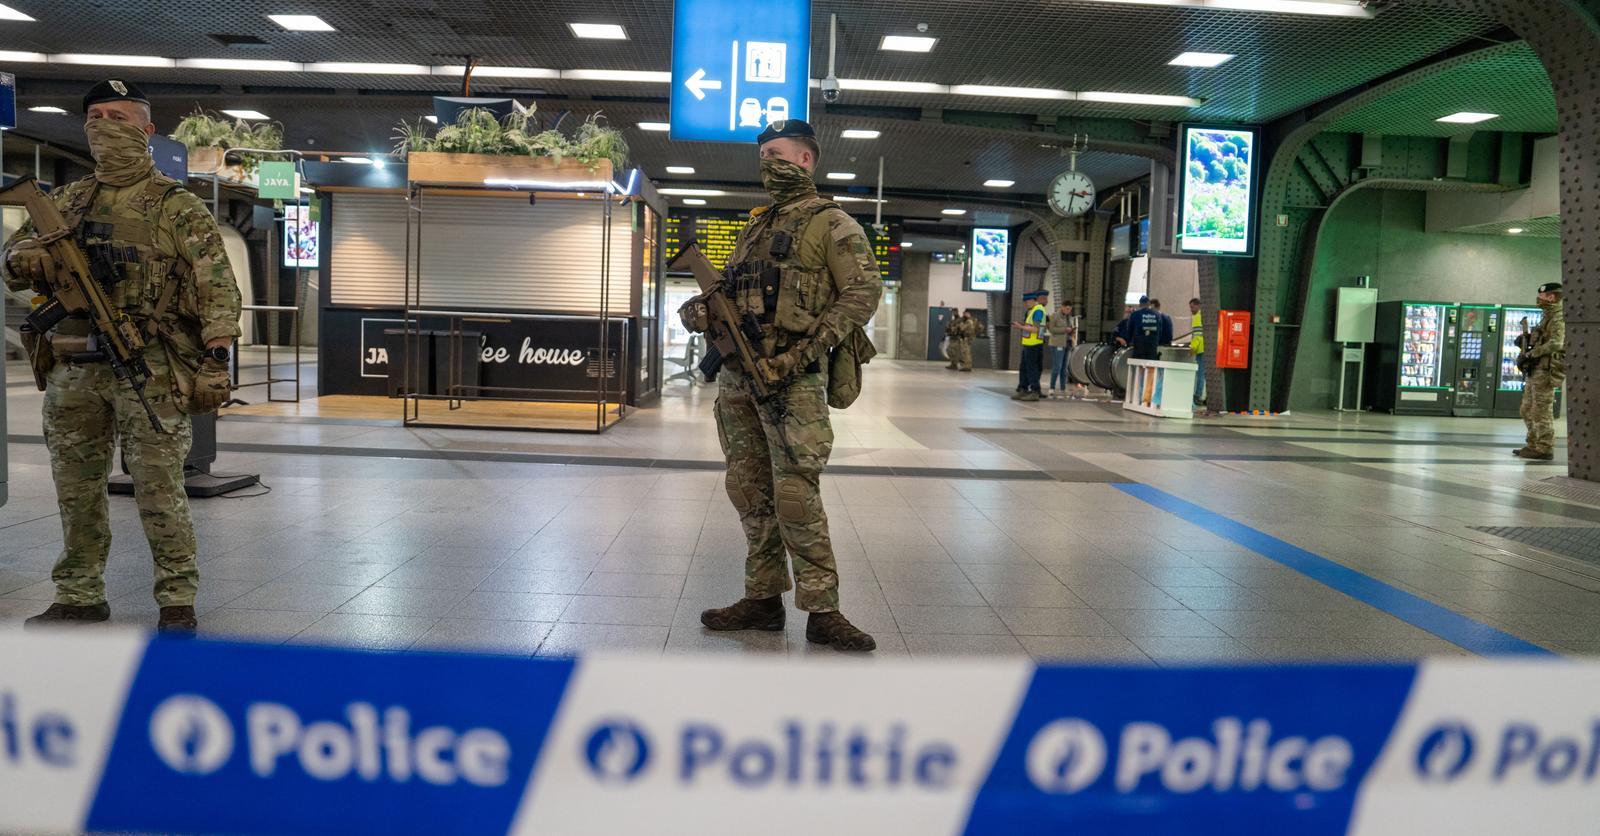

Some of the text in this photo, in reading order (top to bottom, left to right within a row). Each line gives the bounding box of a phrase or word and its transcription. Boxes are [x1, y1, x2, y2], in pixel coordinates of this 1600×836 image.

[264, 178, 289, 186] JAVA
[365, 347, 389, 365] JA
[481, 335, 585, 366] ee house
[245, 701, 511, 786] Police
[678, 720, 959, 789] Politie
[1115, 717, 1354, 792] Police
